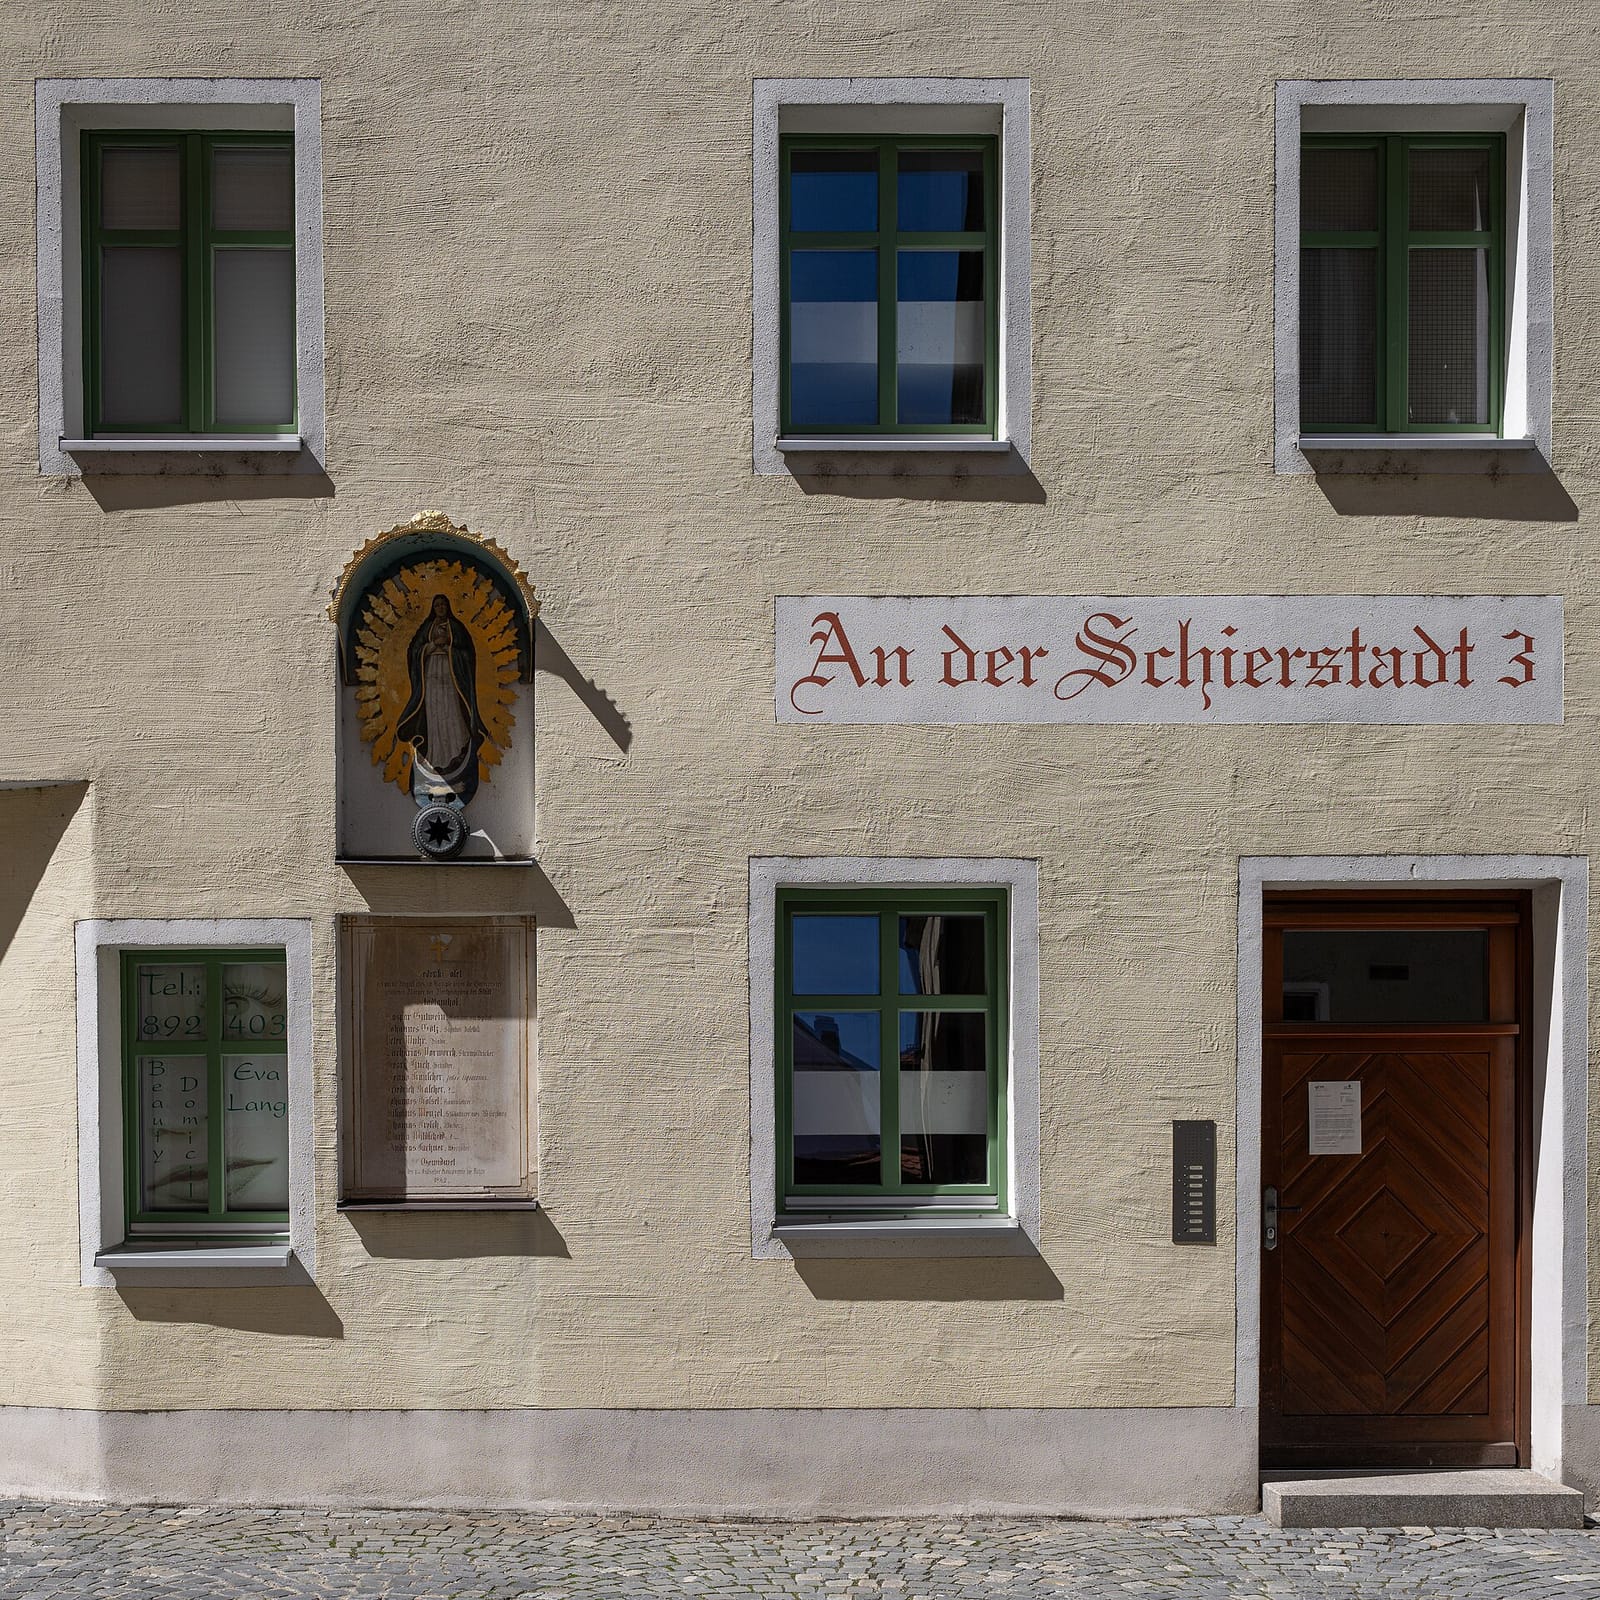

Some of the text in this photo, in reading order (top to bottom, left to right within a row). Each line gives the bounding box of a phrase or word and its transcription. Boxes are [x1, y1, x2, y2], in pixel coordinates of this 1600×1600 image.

[791, 612, 1535, 713] An der Schierstadt 3
[141, 972, 201, 997] Tel.:
[143, 1013, 286, 1038] 892 403
[233, 1062, 280, 1081] Eva
[148, 1060, 166, 1164] Beauty
[227, 1093, 286, 1119] Lang
